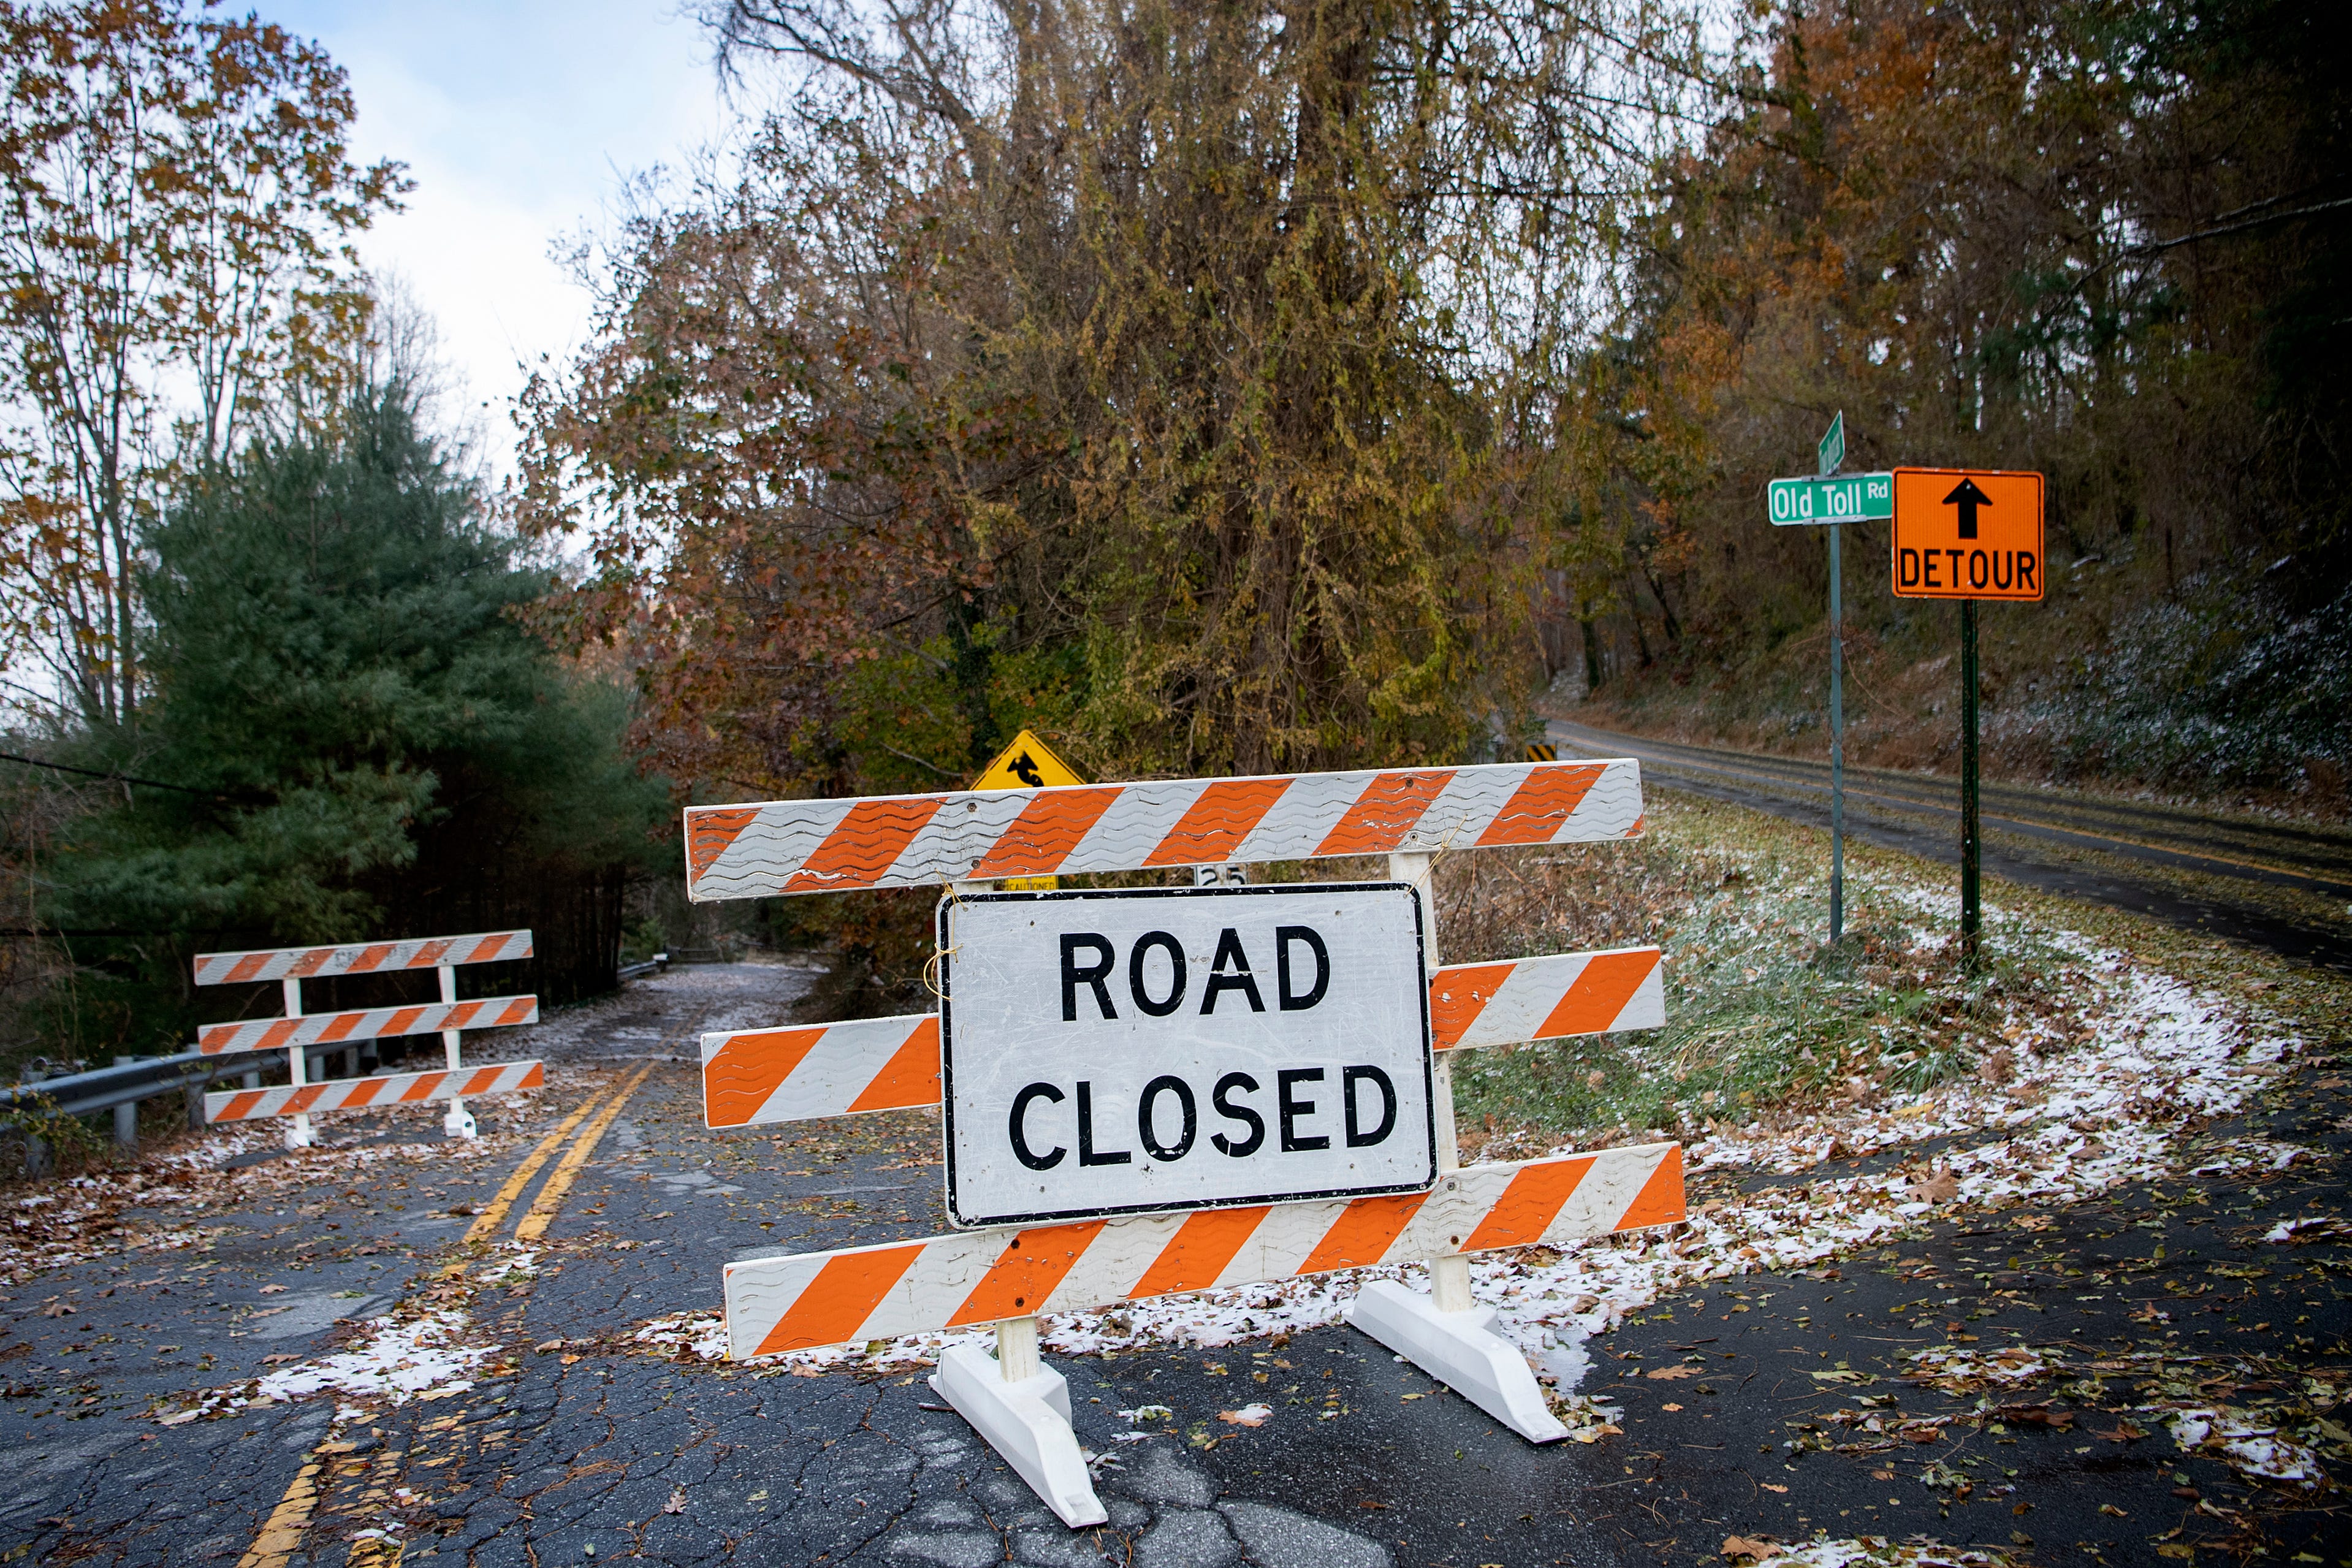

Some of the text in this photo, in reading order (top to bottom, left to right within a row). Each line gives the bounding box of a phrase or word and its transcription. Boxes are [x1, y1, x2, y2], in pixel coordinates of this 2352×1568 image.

[1774, 481, 1889, 519] Old Toll Rd
[1900, 548, 2036, 590] DETOUR
[1200, 867, 1246, 886] 25
[1060, 926, 1330, 1021] ROAD
[1009, 1065, 1397, 1171] CLOSED
